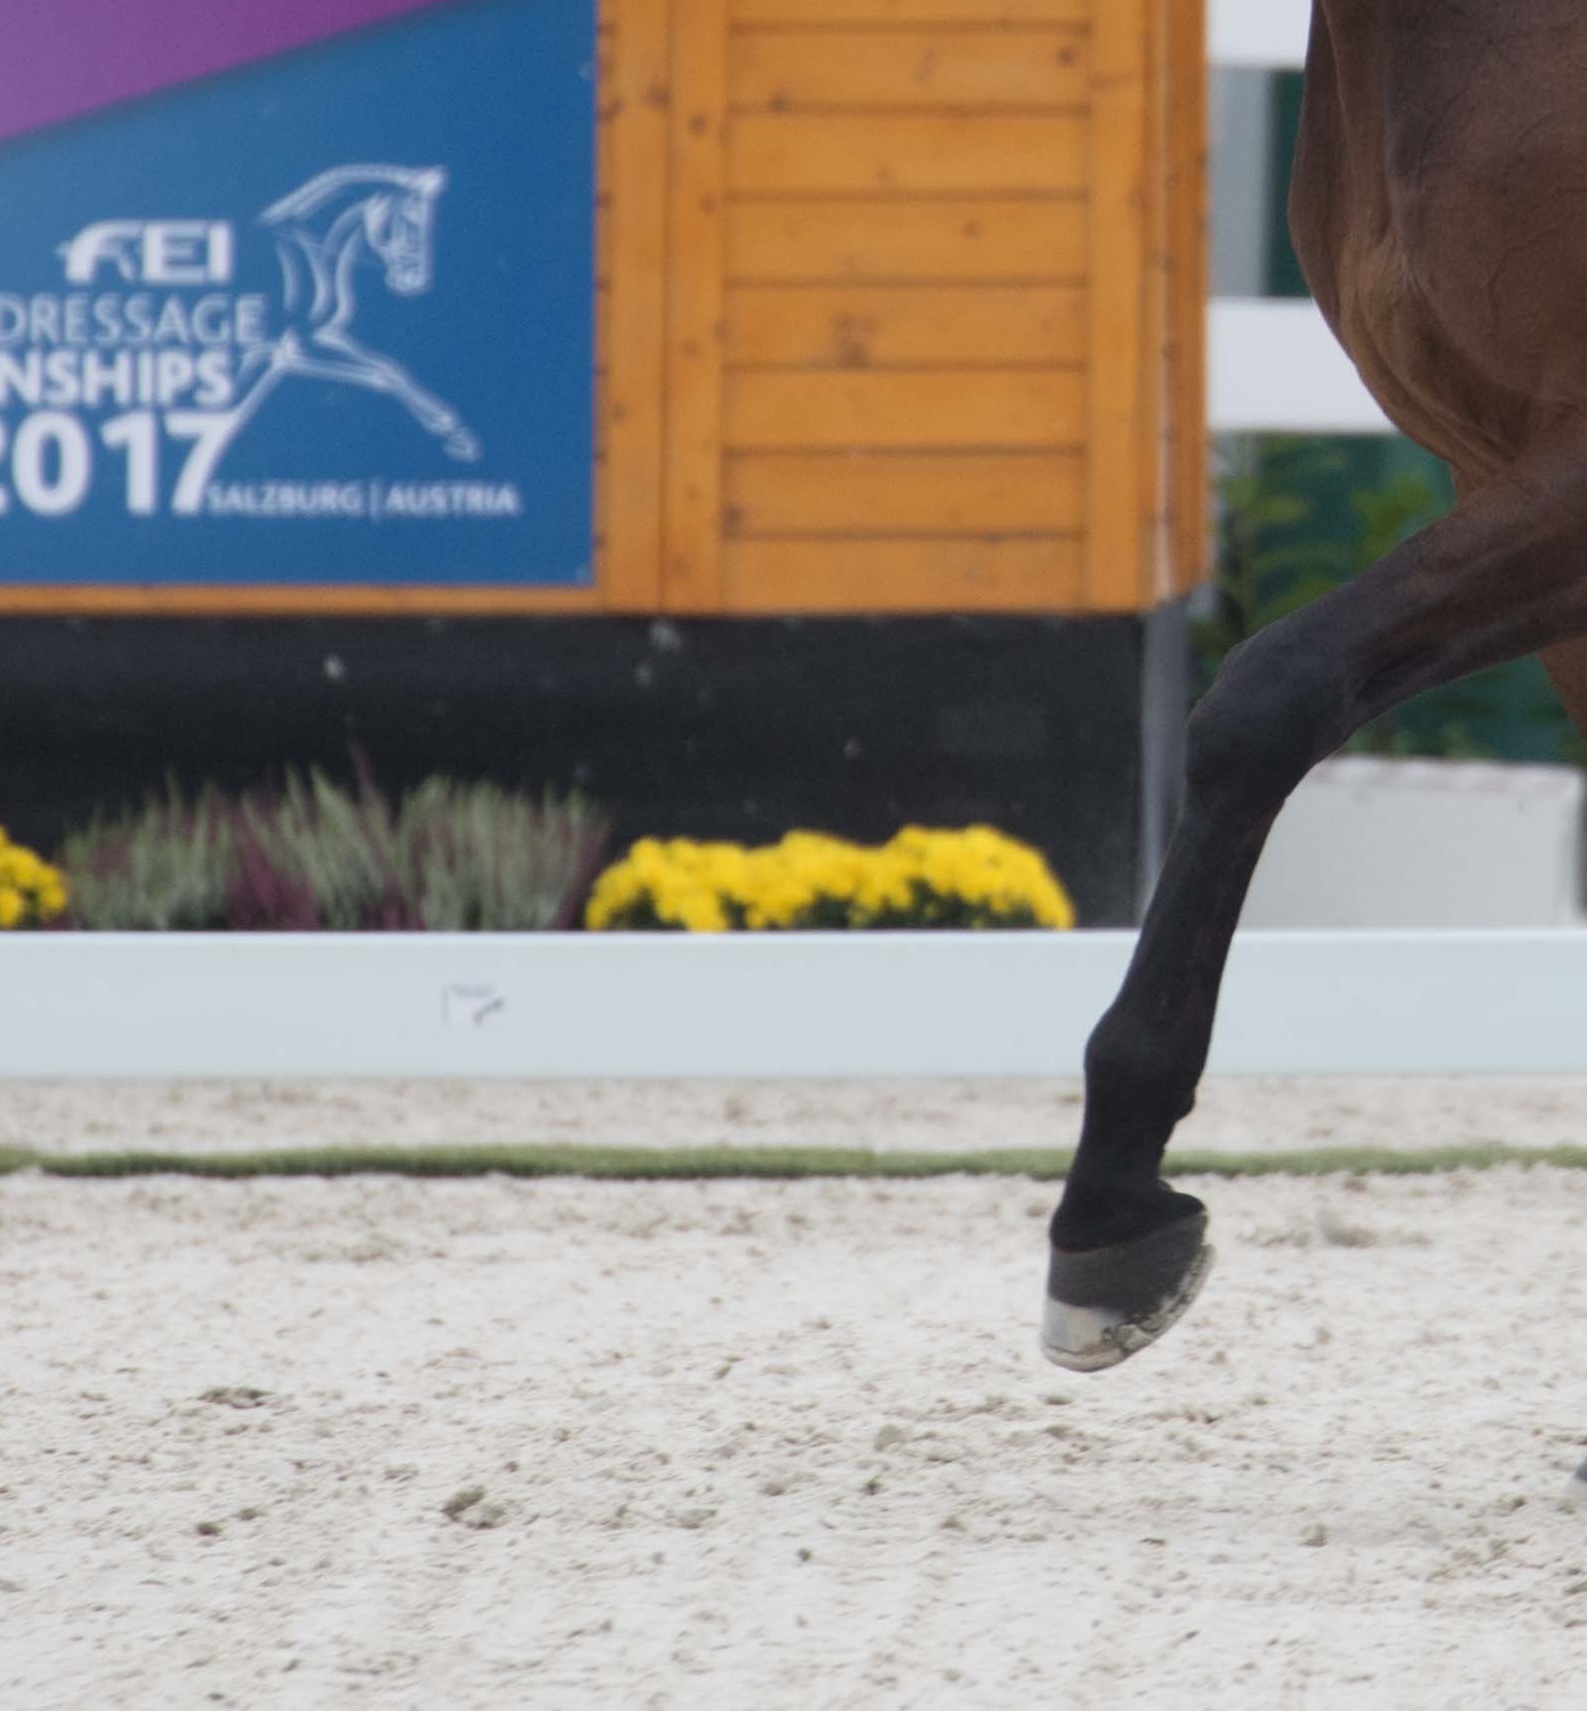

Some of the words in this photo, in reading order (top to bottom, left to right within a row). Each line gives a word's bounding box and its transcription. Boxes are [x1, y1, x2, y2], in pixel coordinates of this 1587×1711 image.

[57, 220, 233, 285] FEI
[209, 483, 364, 515] SALZBURG
[385, 483, 520, 515] AUSTRIA
